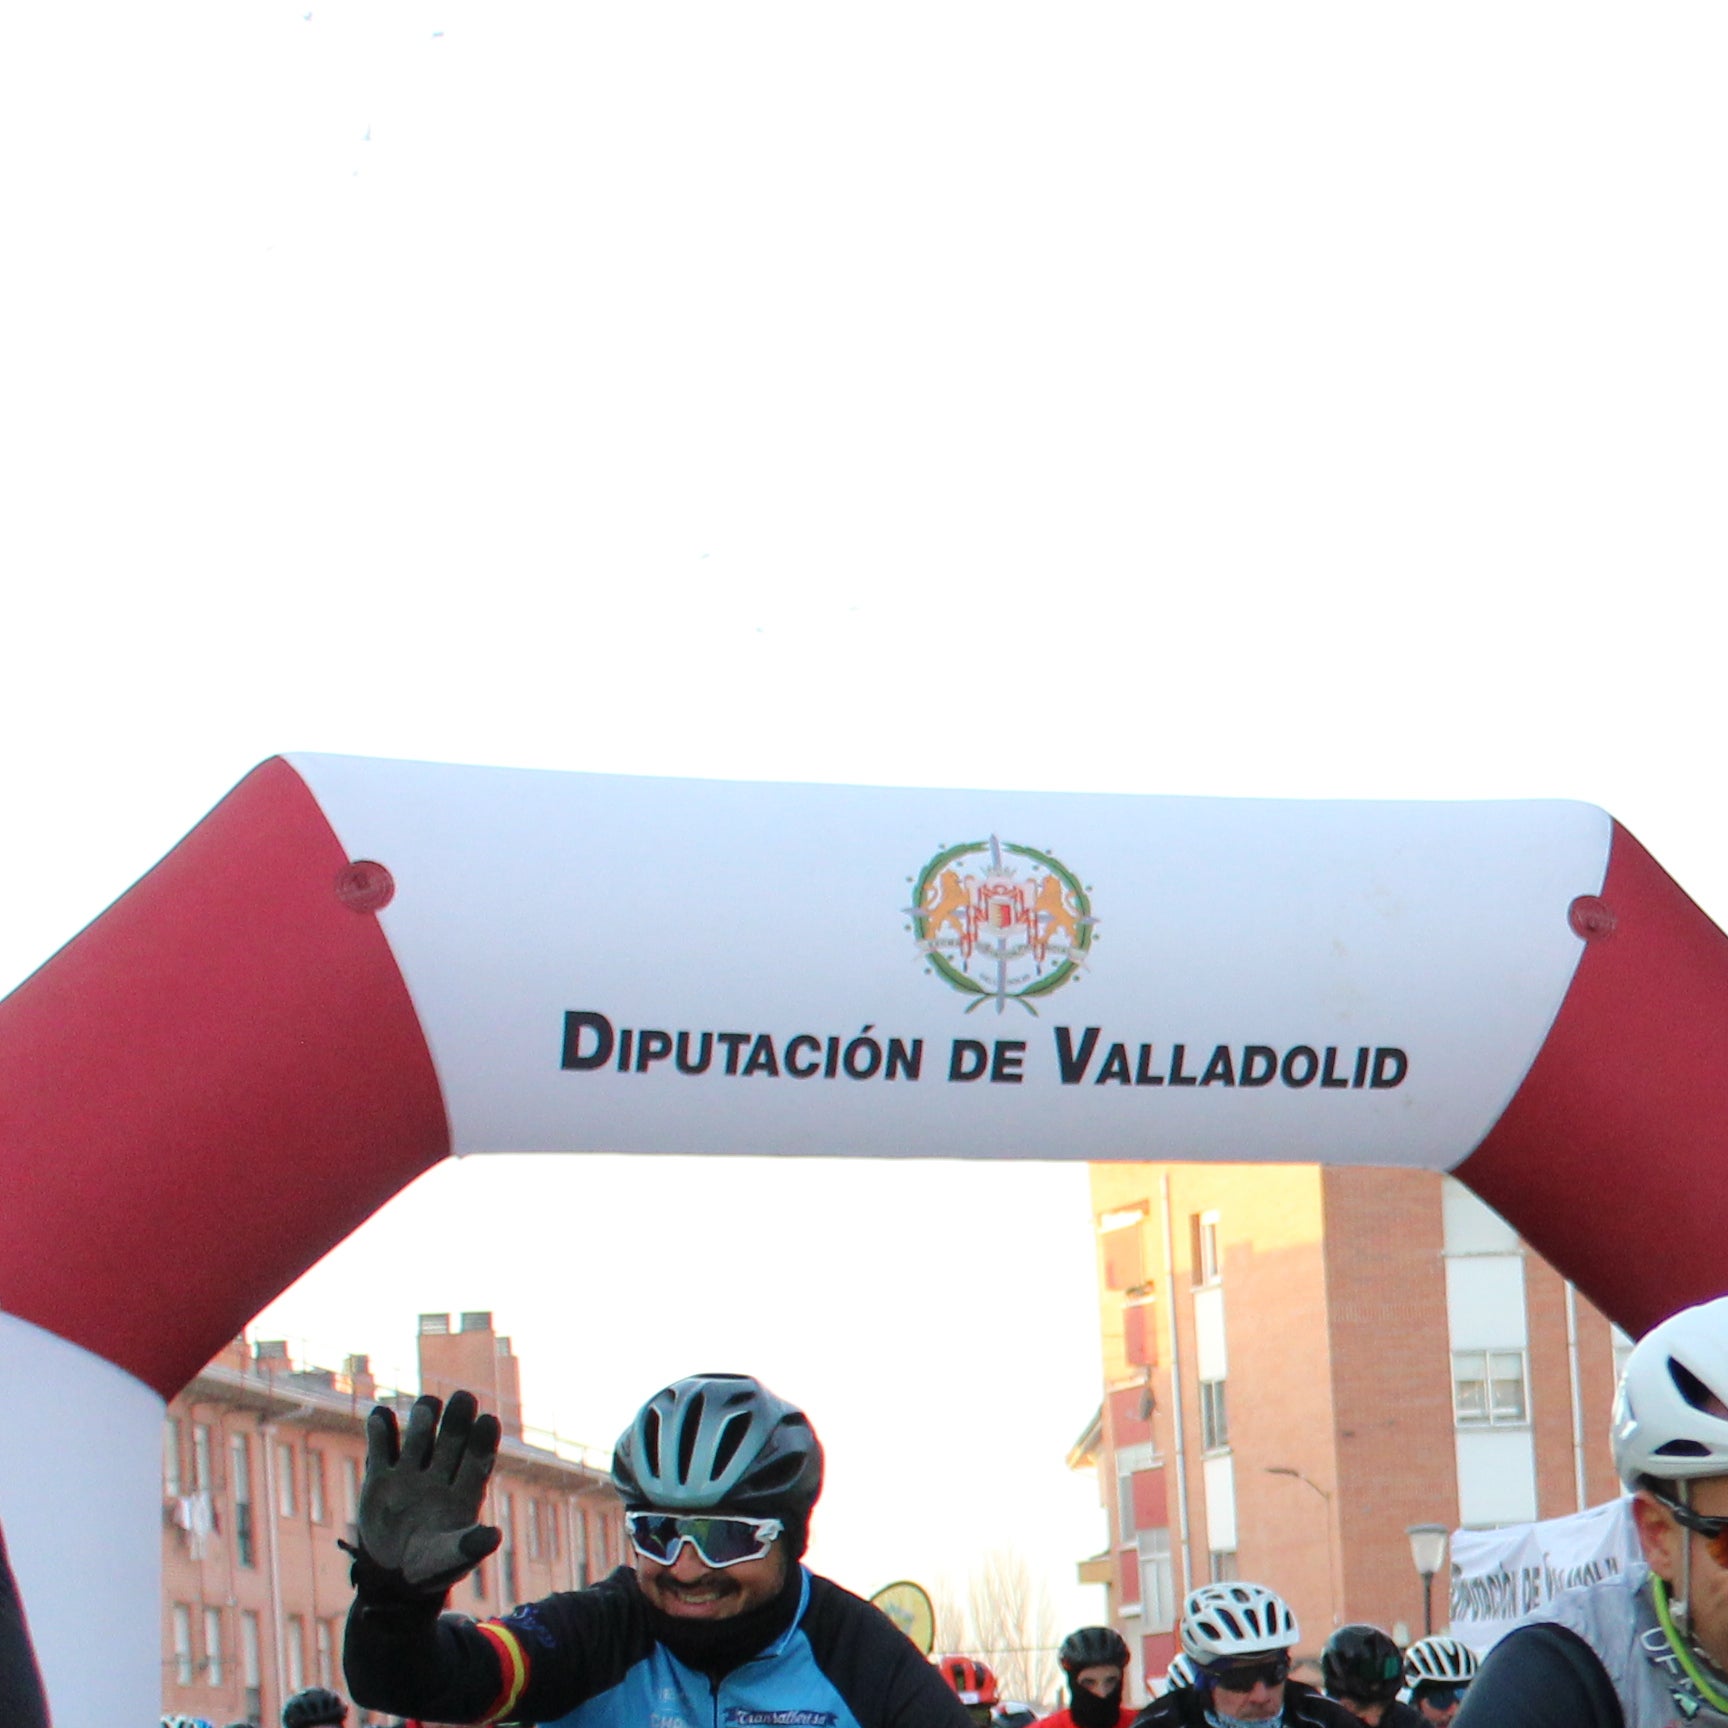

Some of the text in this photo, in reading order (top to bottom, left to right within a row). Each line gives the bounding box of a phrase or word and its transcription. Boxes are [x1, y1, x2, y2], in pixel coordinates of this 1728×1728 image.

[559, 1009, 1410, 1090] DIPUTACIÓN DE VALLADOLID
